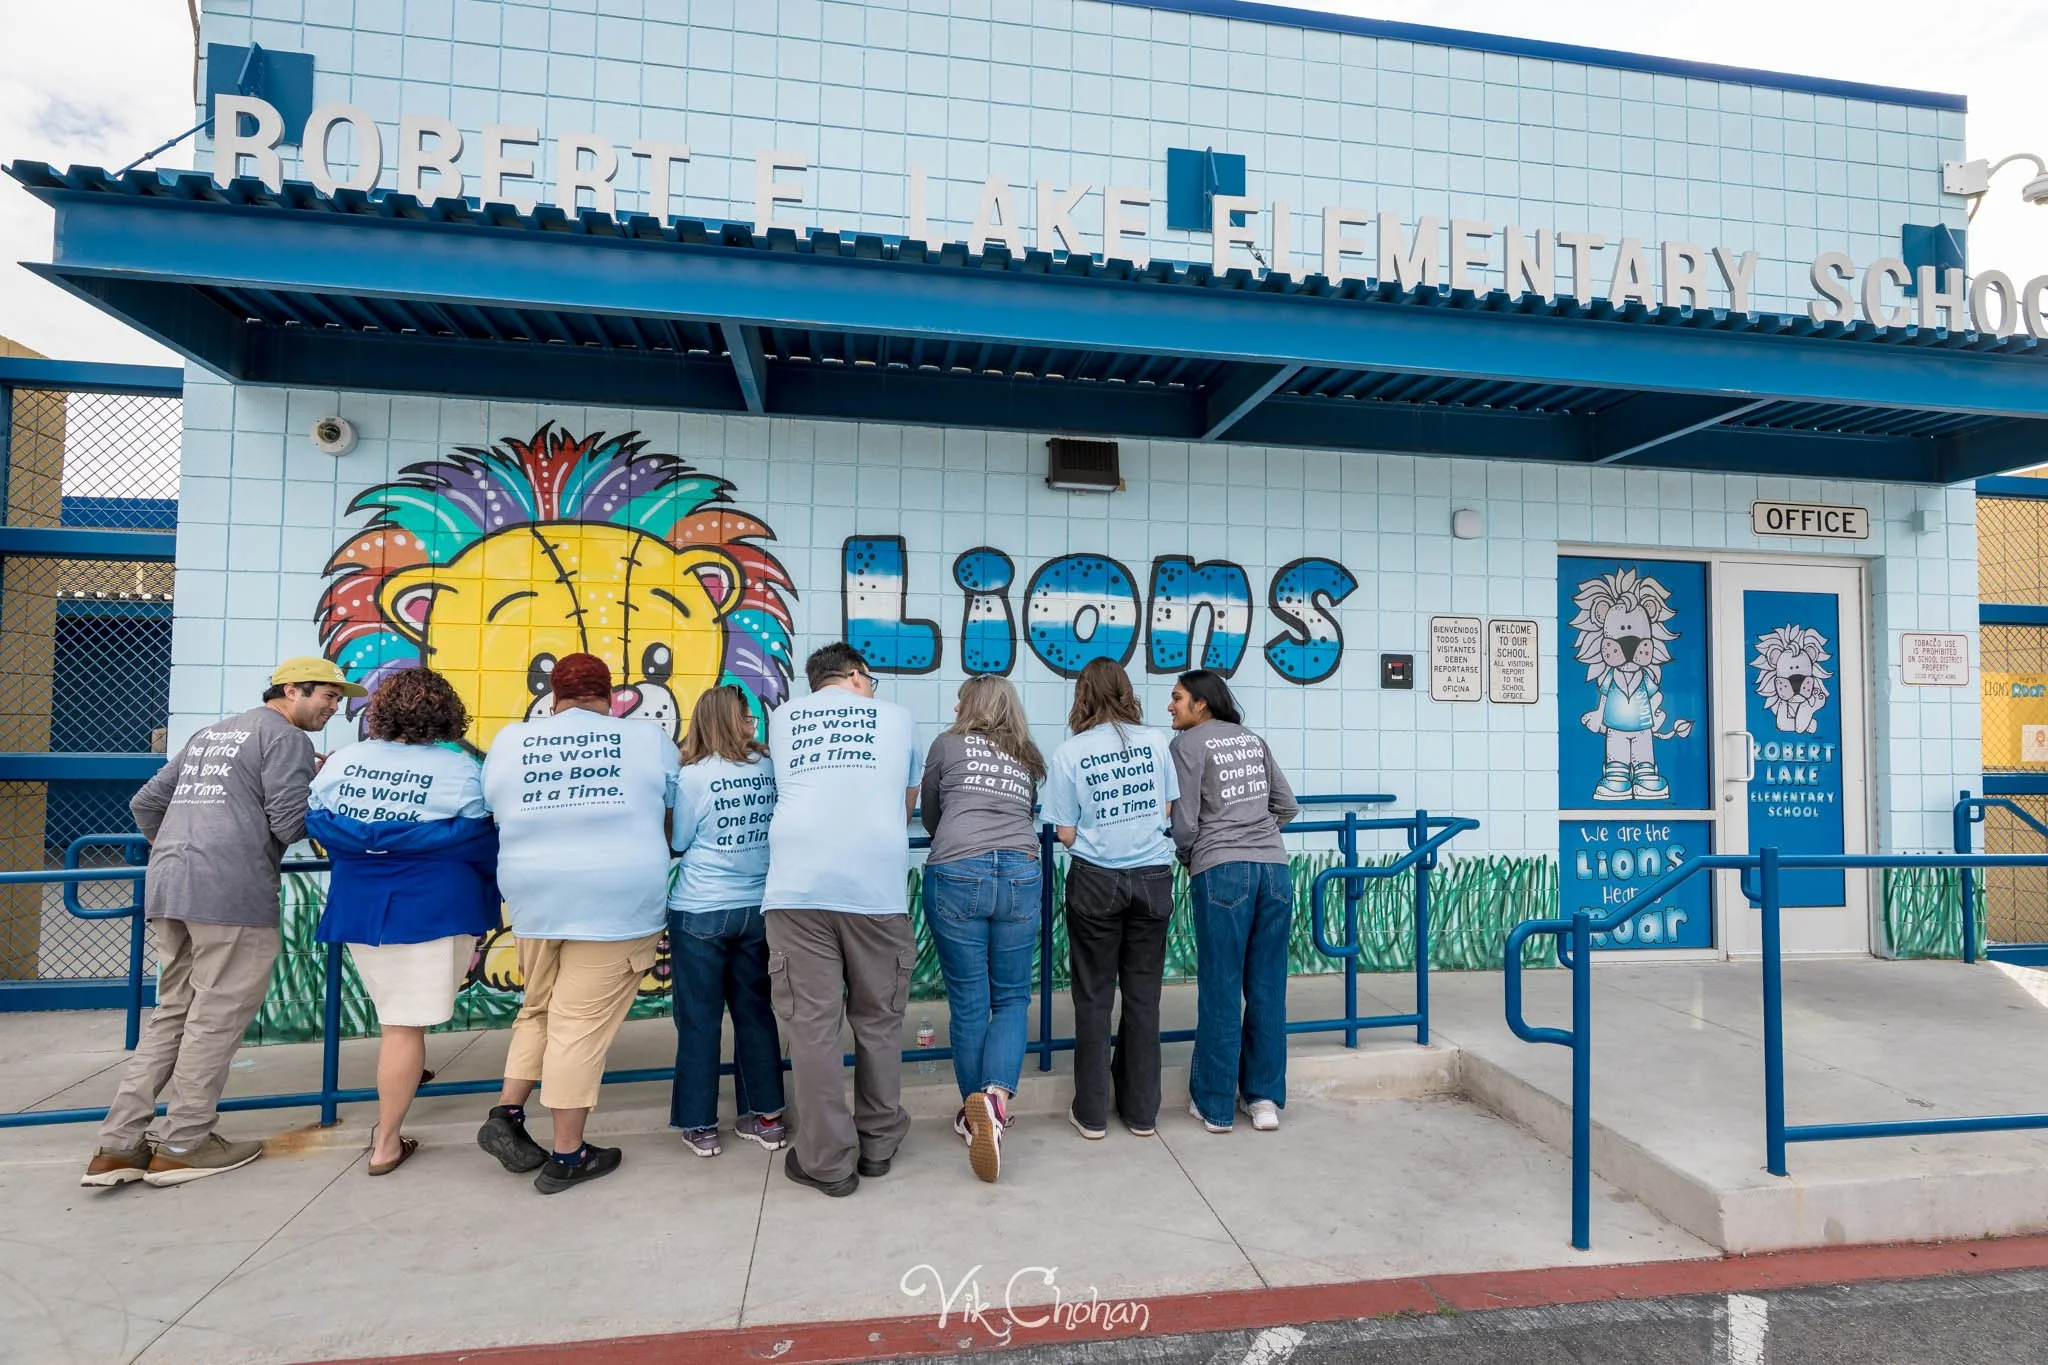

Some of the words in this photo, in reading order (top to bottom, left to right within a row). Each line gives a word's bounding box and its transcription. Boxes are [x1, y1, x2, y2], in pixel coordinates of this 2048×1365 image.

[214, 93, 690, 226] ROBERT
[909, 164, 1151, 268] LAKE
[1212, 195, 1758, 315] ELEMENTARY
[1766, 508, 1857, 533] OFFICE
[1433, 626, 1479, 634] BIENVENIDOS
[1495, 624, 1532, 634] WELCOME
[1436, 636, 1459, 644] TODOS
[1462, 636, 1476, 644] LOS
[1499, 636, 1509, 646] TO
[1511, 637, 1527, 646] OUR
[1914, 639, 1941, 647] TOBACCO
[1437, 645, 1476, 654] VISITANTES
[1922, 648, 1957, 656] PROHIBITED
[1917, 656, 1939, 664] SCHOOL
[1433, 665, 1479, 673] REPORTARSE
[1442, 685, 1470, 693] OFICINA
[790, 706, 877, 721] Changing
[792, 723, 817, 736] the
[822, 719, 876, 729] World
[197, 728, 251, 744] hanging
[523, 732, 621, 747] Changing
[792, 736, 824, 750] One
[829, 733, 875, 744] Book
[1205, 732, 1260, 749] Changing
[522, 753, 553, 765] the
[559, 747, 621, 762] World
[790, 754, 805, 769] at
[809, 753, 820, 762] a
[827, 748, 876, 761] Time.
[965, 748, 992, 757] the
[1080, 746, 1152, 769] Changing
[1213, 752, 1234, 765] the
[1753, 741, 1836, 763] ROBERT
[524, 770, 563, 783] One
[569, 765, 622, 780] Book
[967, 761, 999, 772] One
[1086, 772, 1109, 786] the
[1112, 761, 1154, 779] World
[1219, 768, 1245, 781] One
[1246, 764, 1265, 776] Boo
[343, 765, 433, 789] Changing
[963, 775, 982, 784] at
[985, 777, 996, 787] a
[1766, 765, 1819, 786] LAKE
[339, 783, 366, 798] the
[372, 786, 427, 804] World
[522, 790, 542, 803] at
[547, 790, 560, 800] a
[568, 784, 624, 799] Time.
[1093, 788, 1119, 802] One
[1122, 778, 1155, 796] Book
[1221, 785, 1237, 799] at
[1238, 785, 1245, 794] a
[1750, 791, 1835, 803] ELEMENTARY
[714, 798, 741, 811] the
[1110, 806, 1118, 816] a
[1768, 806, 1819, 818] SCHOOL
[338, 803, 369, 819] One
[373, 807, 421, 822] Book
[717, 815, 746, 829] One
[749, 812, 774, 825] Boo
[716, 834, 733, 846] at
[736, 834, 745, 844] a
[1580, 825, 1609, 843] We
[1617, 826, 1641, 842] are
[1645, 824, 1671, 842] the
